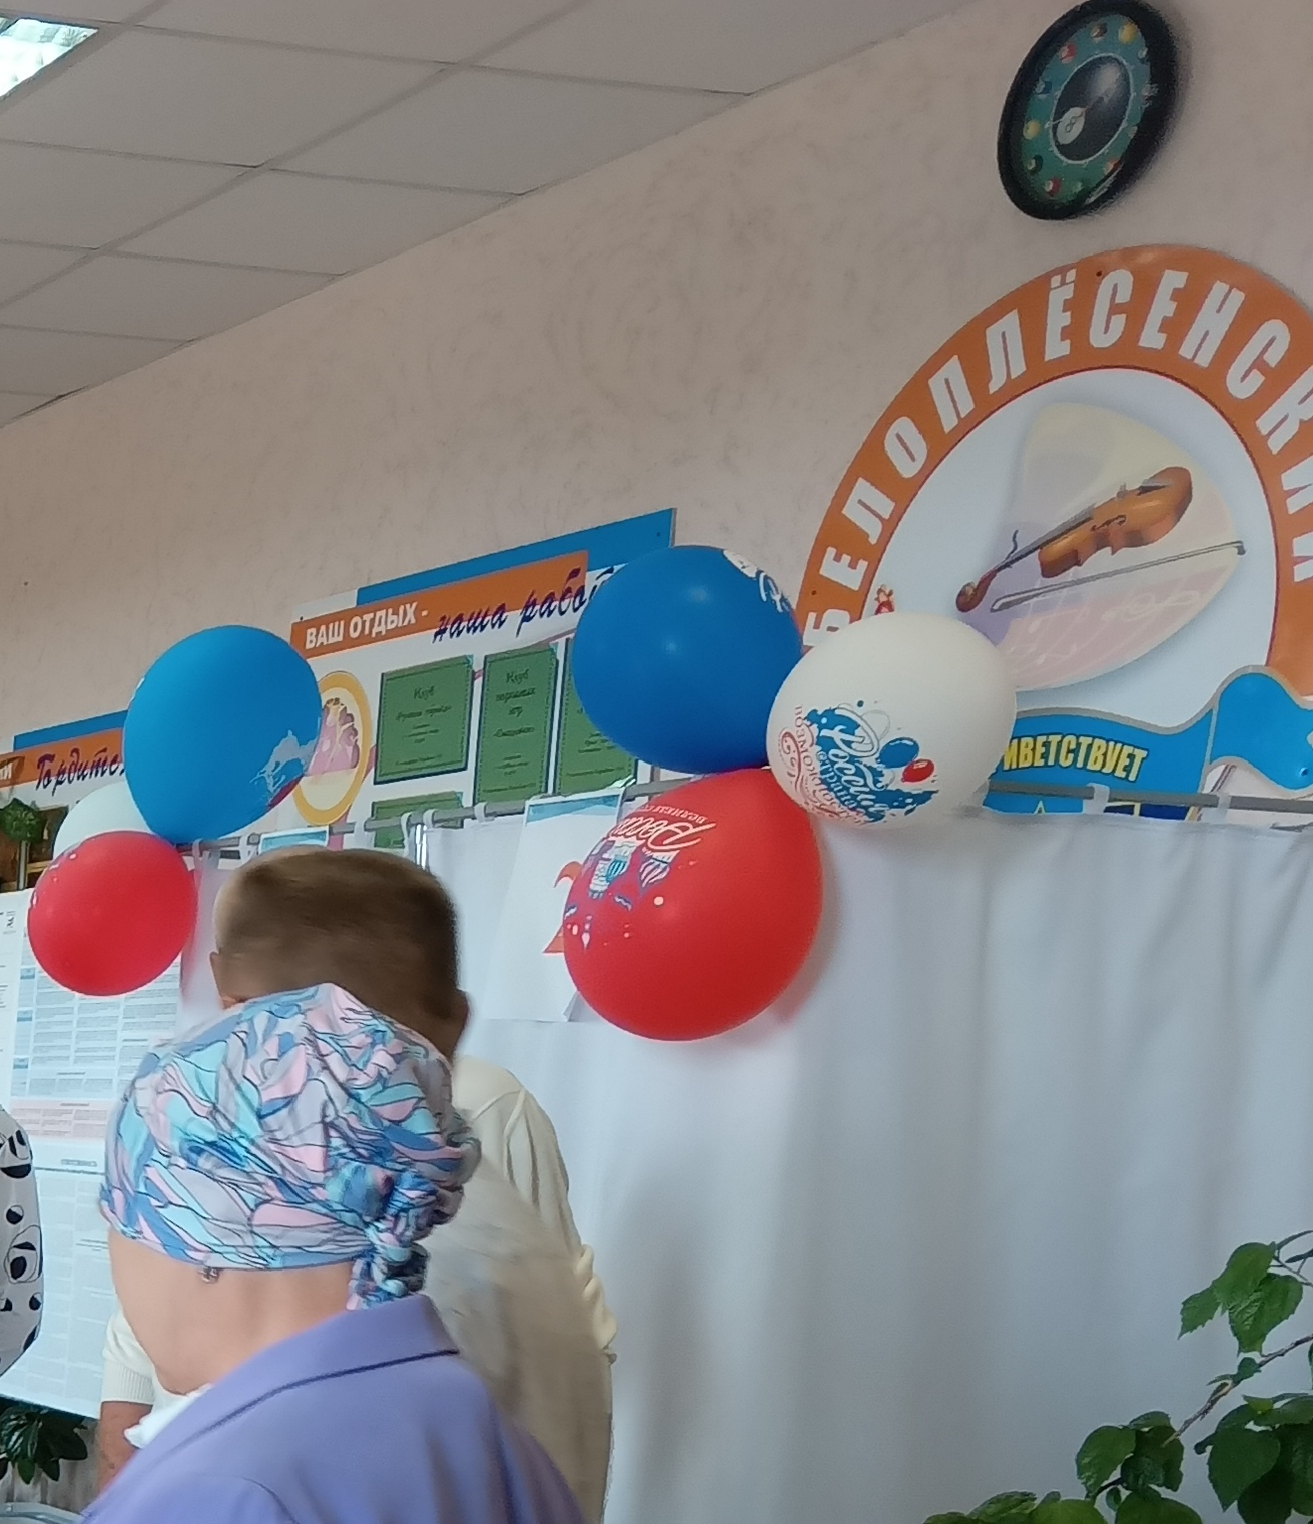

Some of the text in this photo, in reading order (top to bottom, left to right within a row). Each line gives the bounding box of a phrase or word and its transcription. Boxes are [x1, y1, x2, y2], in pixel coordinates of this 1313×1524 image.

[803, 268, 1313, 647] БЕЛОПЛЁСЕНСК
[305, 617, 344, 650] ВАШ
[349, 602, 419, 638] ОТДЫХ
[431, 602, 508, 644] наша
[514, 566, 615, 638] рабо
[1002, 733, 1148, 782] ИВЕТСТВУЕТ
